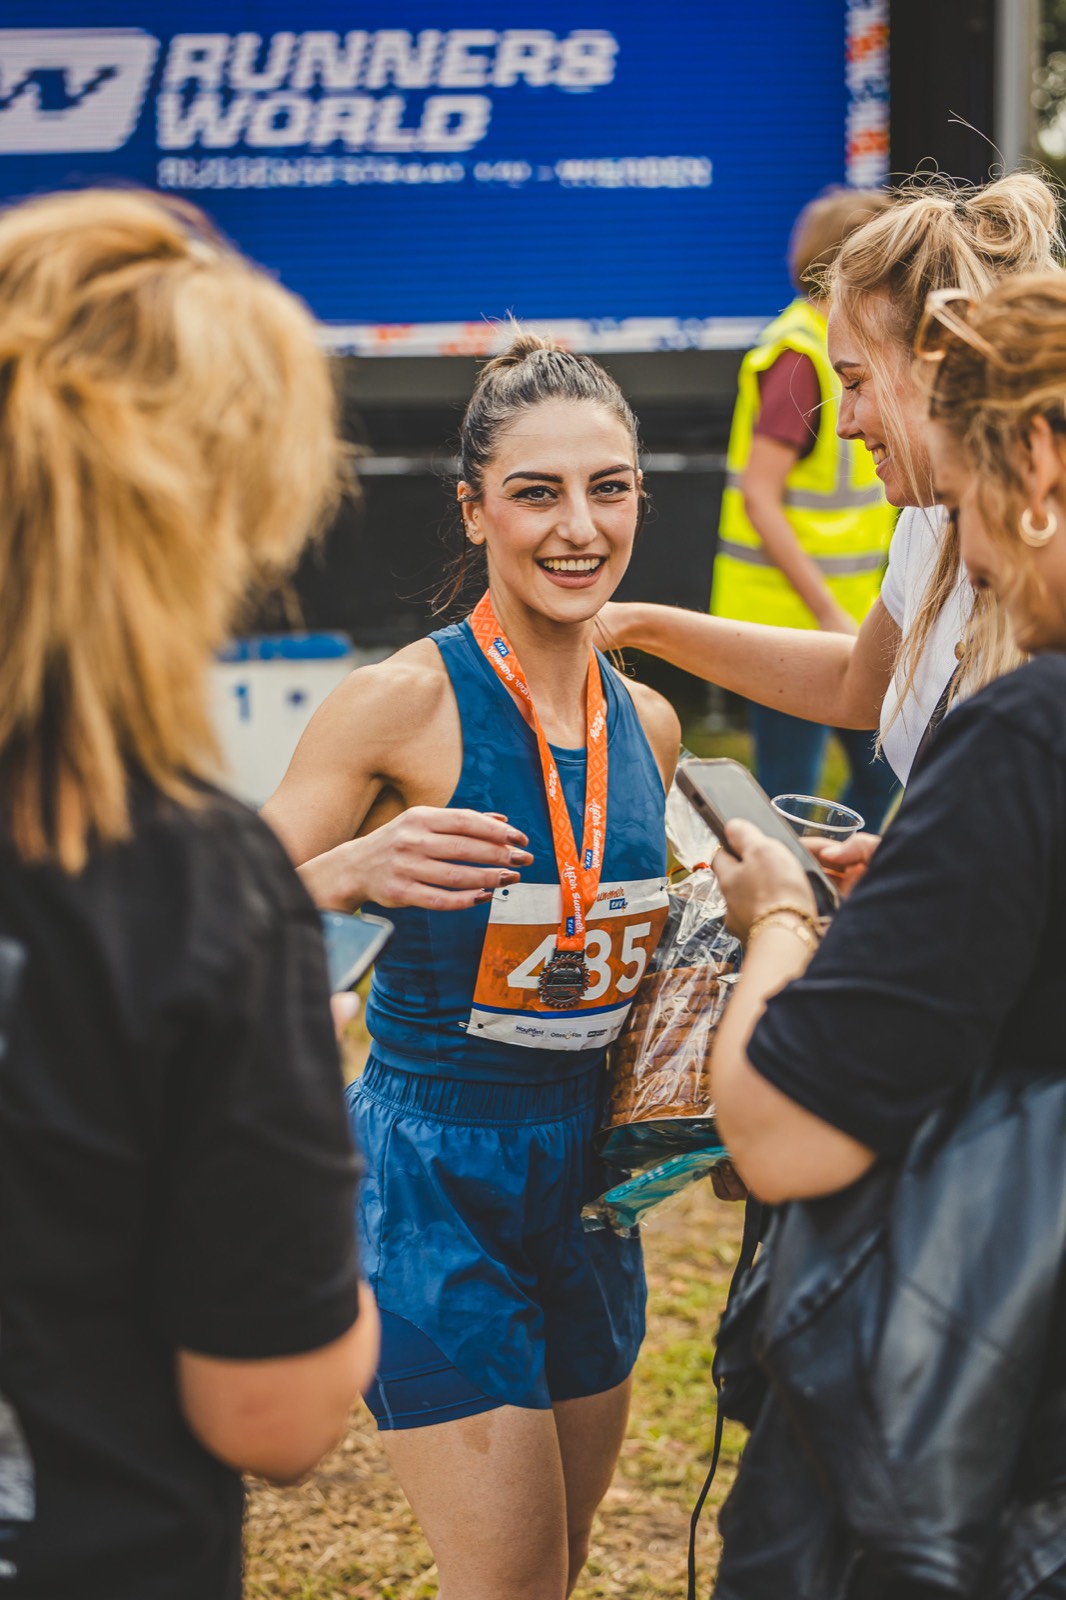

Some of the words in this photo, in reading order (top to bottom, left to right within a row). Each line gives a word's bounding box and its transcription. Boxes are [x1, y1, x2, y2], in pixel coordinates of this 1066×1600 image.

[164, 29, 619, 91] RUNNERS
[156, 92, 492, 151] WORLD
[506, 921, 652, 1002] 485
